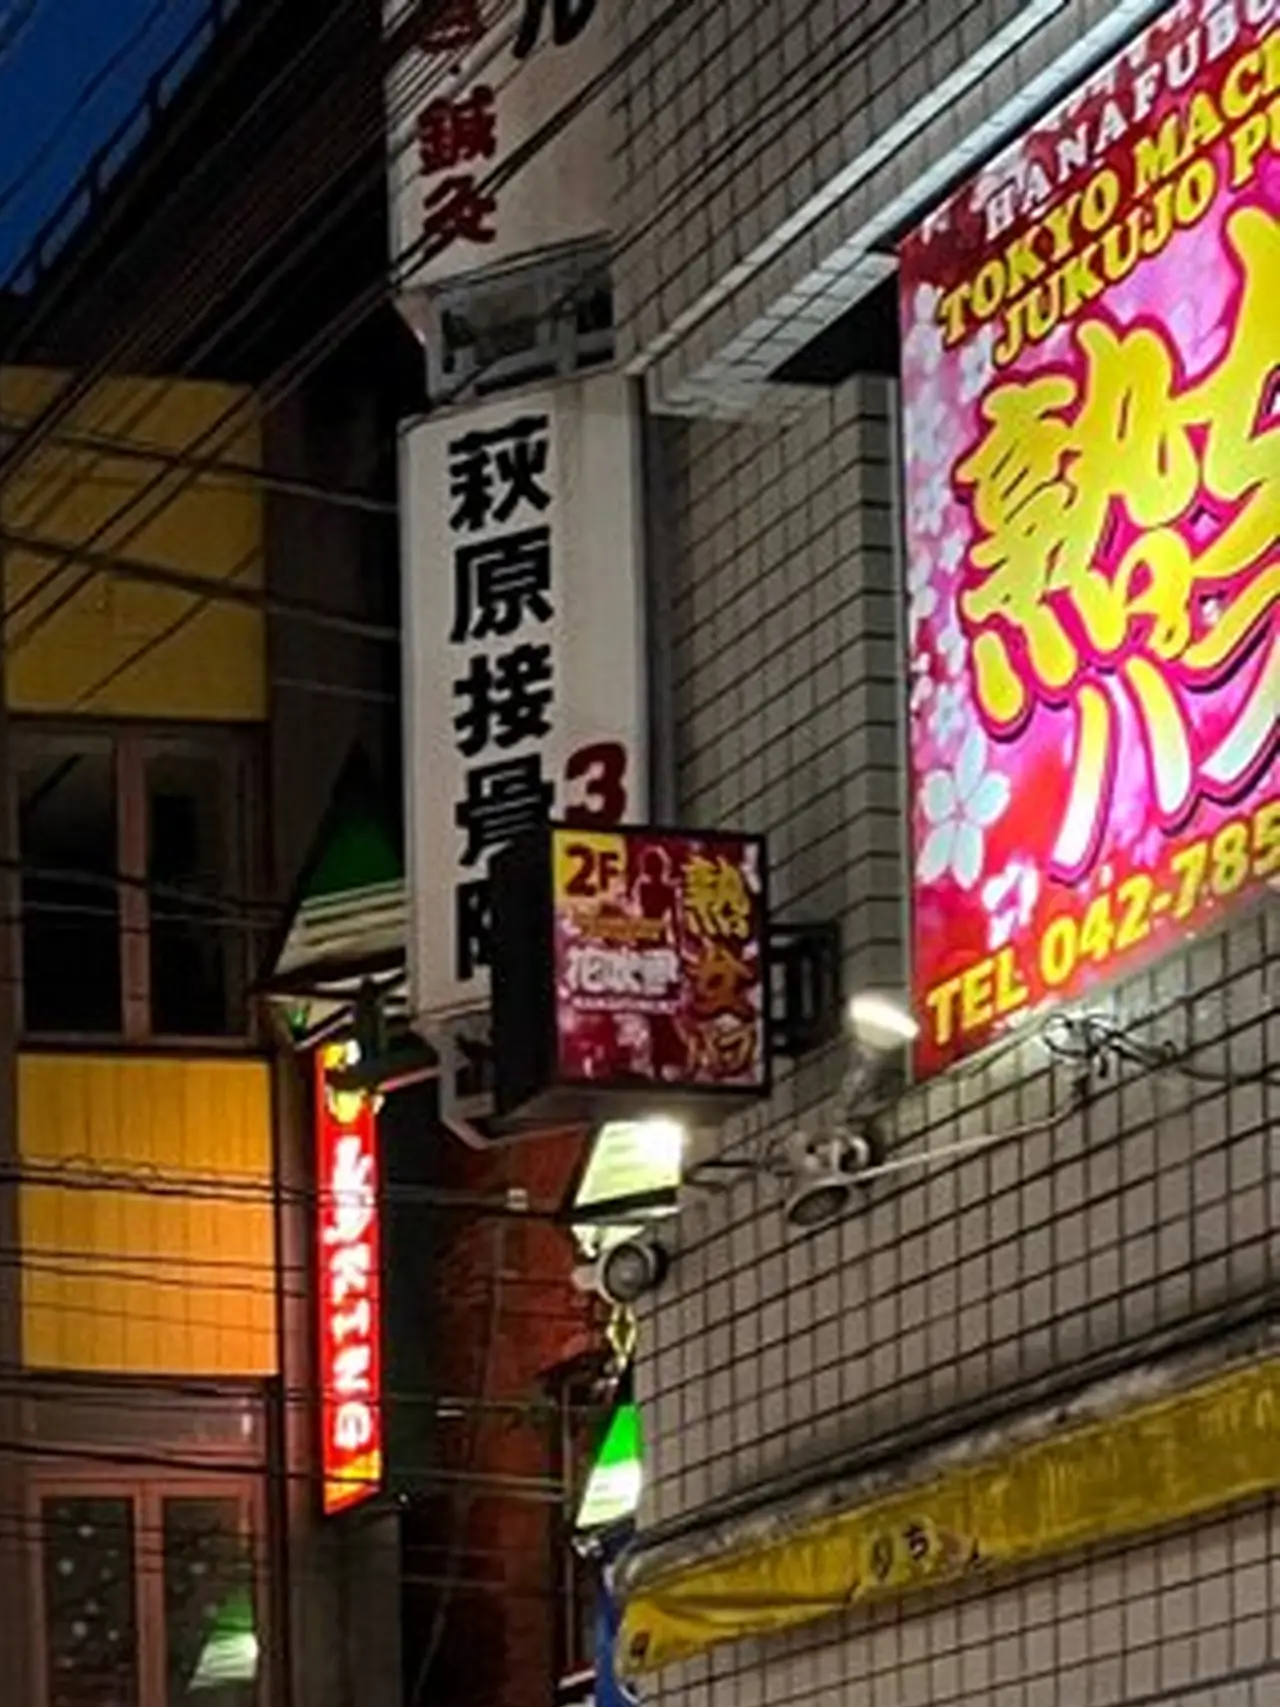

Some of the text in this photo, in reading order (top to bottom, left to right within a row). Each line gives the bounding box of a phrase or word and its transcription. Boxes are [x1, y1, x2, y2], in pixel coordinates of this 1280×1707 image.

[940, 169, 1120, 346] TOKYO
[994, 159, 1216, 366] JUKUJO
[565, 844, 620, 898] 2F
[928, 947, 1028, 1044] TEL
